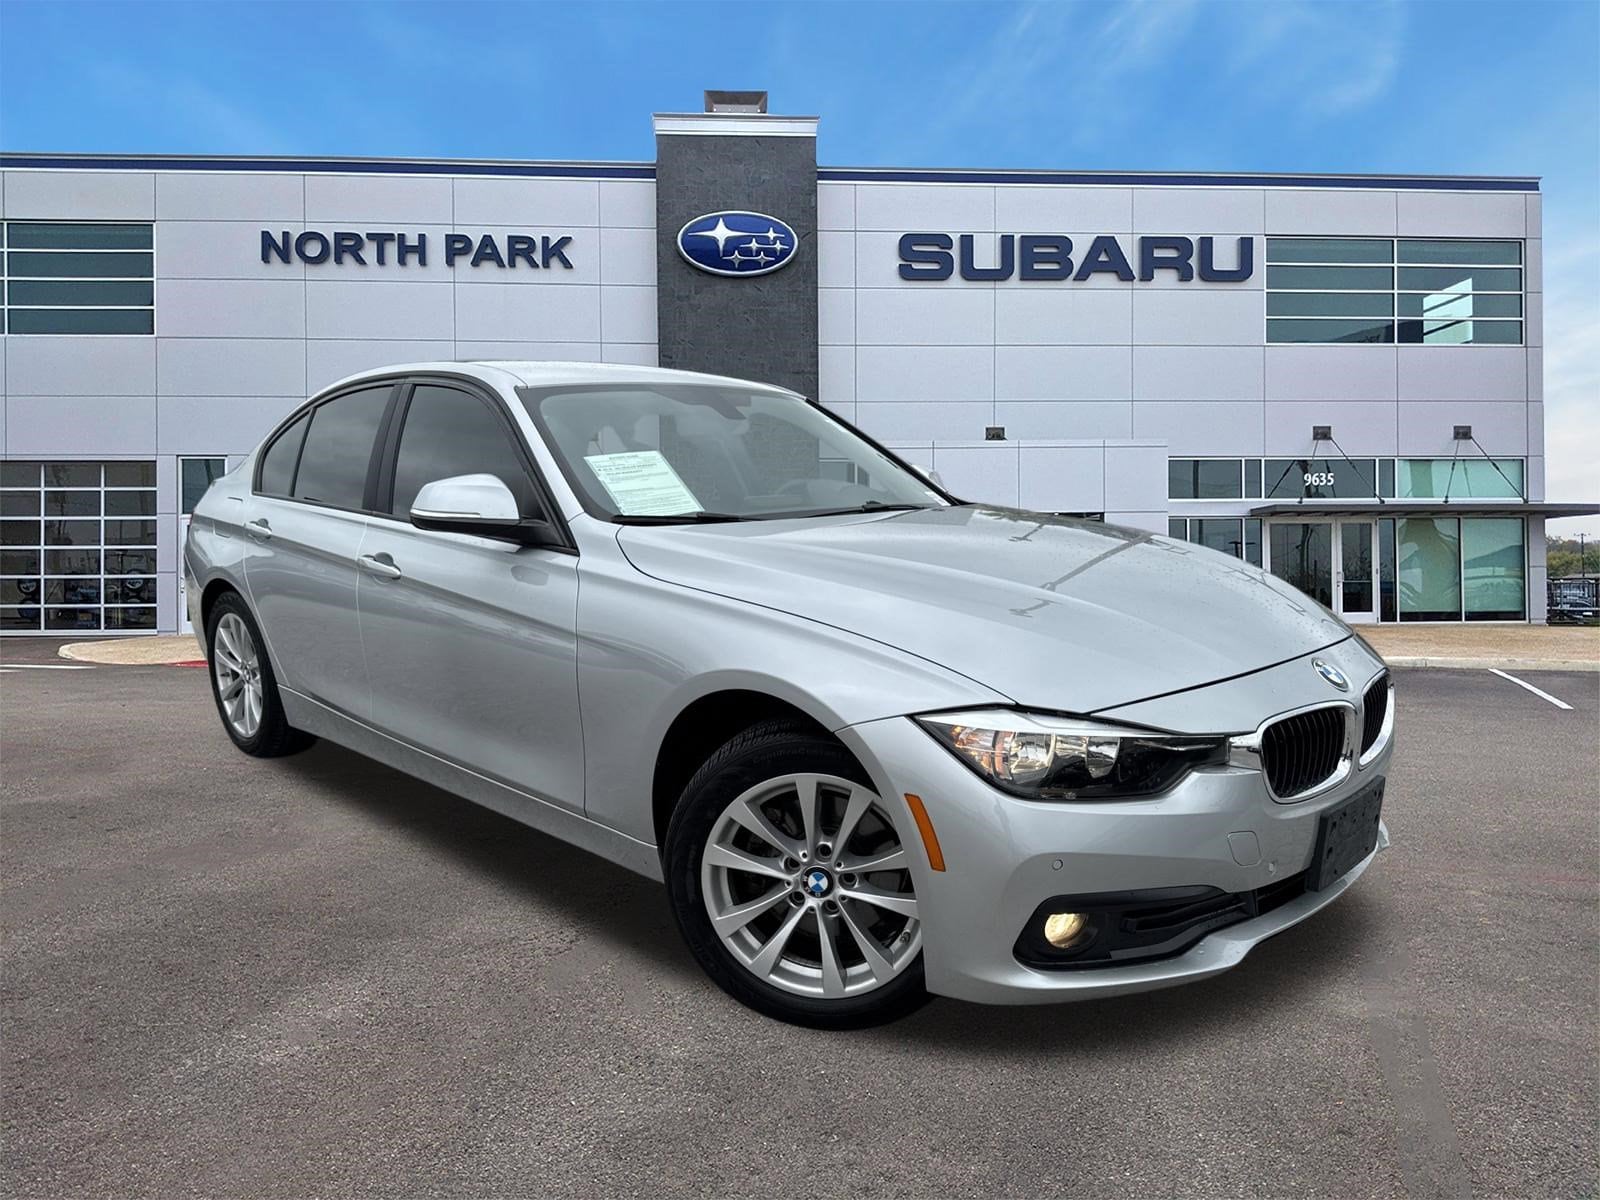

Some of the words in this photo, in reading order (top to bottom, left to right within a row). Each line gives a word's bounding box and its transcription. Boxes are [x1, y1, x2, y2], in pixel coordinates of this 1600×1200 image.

[261, 231, 427, 267] NORTH
[445, 234, 573, 269] PARK
[899, 234, 1253, 283] SUBARU
[1303, 473, 1335, 486] 9635
